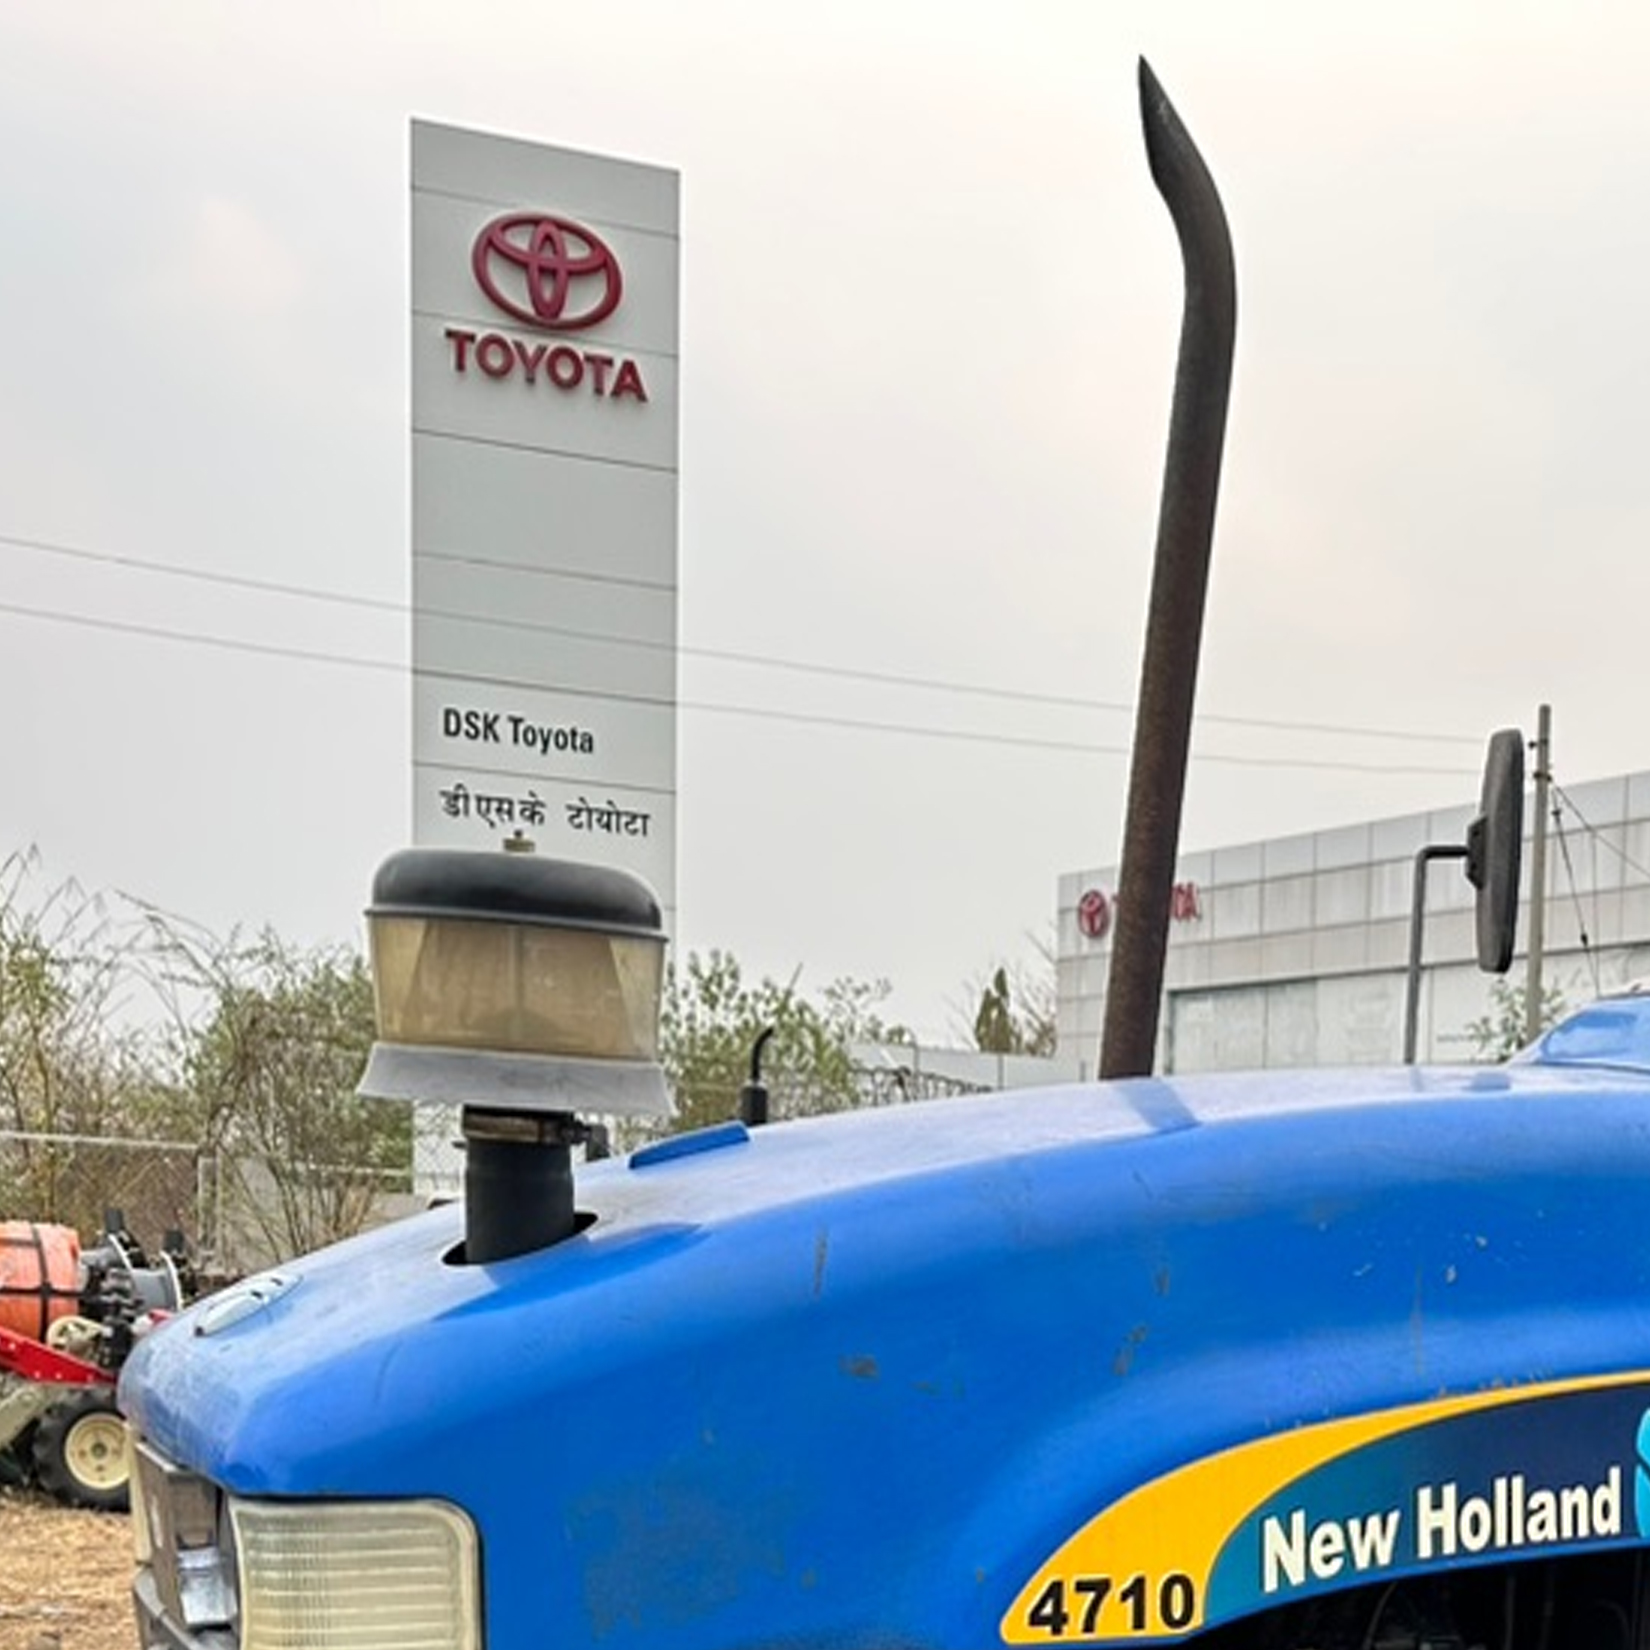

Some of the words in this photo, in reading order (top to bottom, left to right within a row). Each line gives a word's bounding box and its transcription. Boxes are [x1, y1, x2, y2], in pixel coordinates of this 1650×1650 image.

[445, 327, 648, 403] TOYOTA
[443, 707, 500, 743] DSK
[507, 714, 595, 755] Toyota
[565, 796, 651, 837] टोयोटा
[1261, 1509, 1400, 1594] New
[1415, 1466, 1623, 1559] Holland
[1028, 1572, 1196, 1637] 4710
